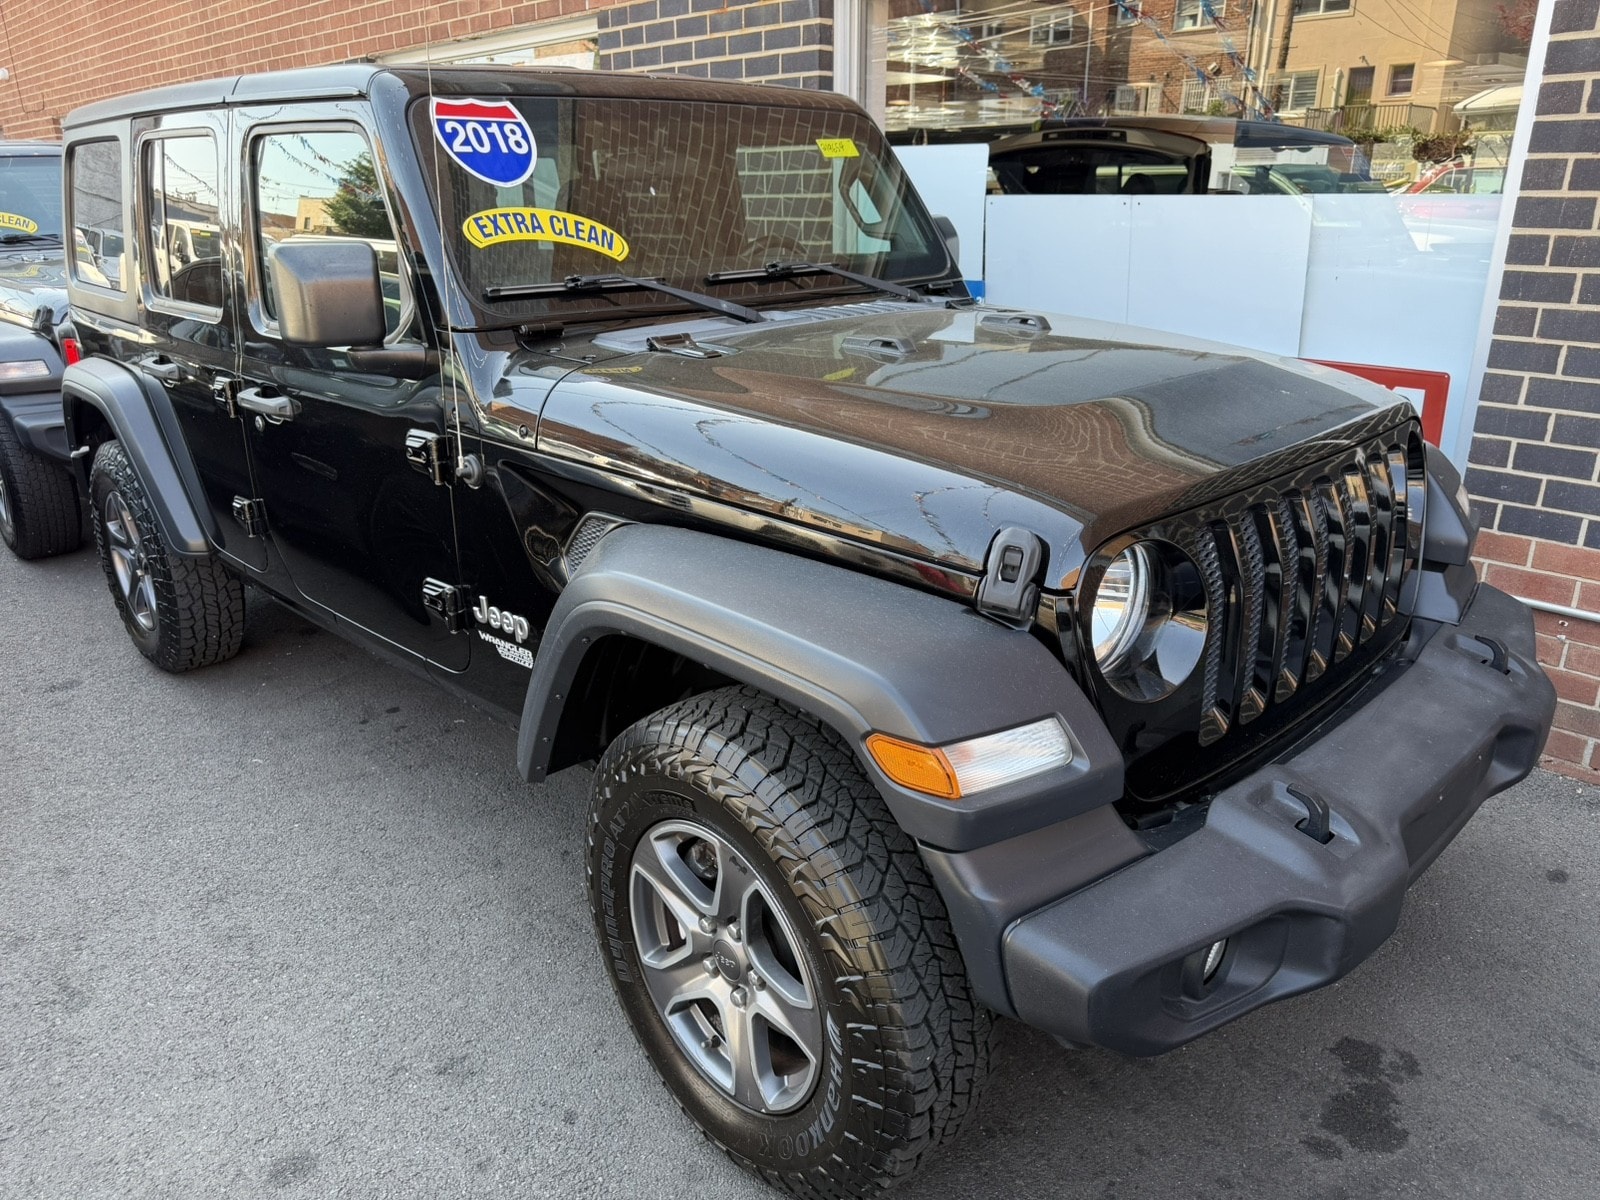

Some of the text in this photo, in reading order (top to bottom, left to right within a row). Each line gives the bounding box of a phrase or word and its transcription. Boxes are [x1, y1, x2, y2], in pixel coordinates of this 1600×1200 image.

[445, 121, 530, 155] 2018
[471, 212, 615, 251] EXTRA CLEAN
[472, 595, 530, 644] Jeep
[478, 629, 533, 657] WRANGLER
